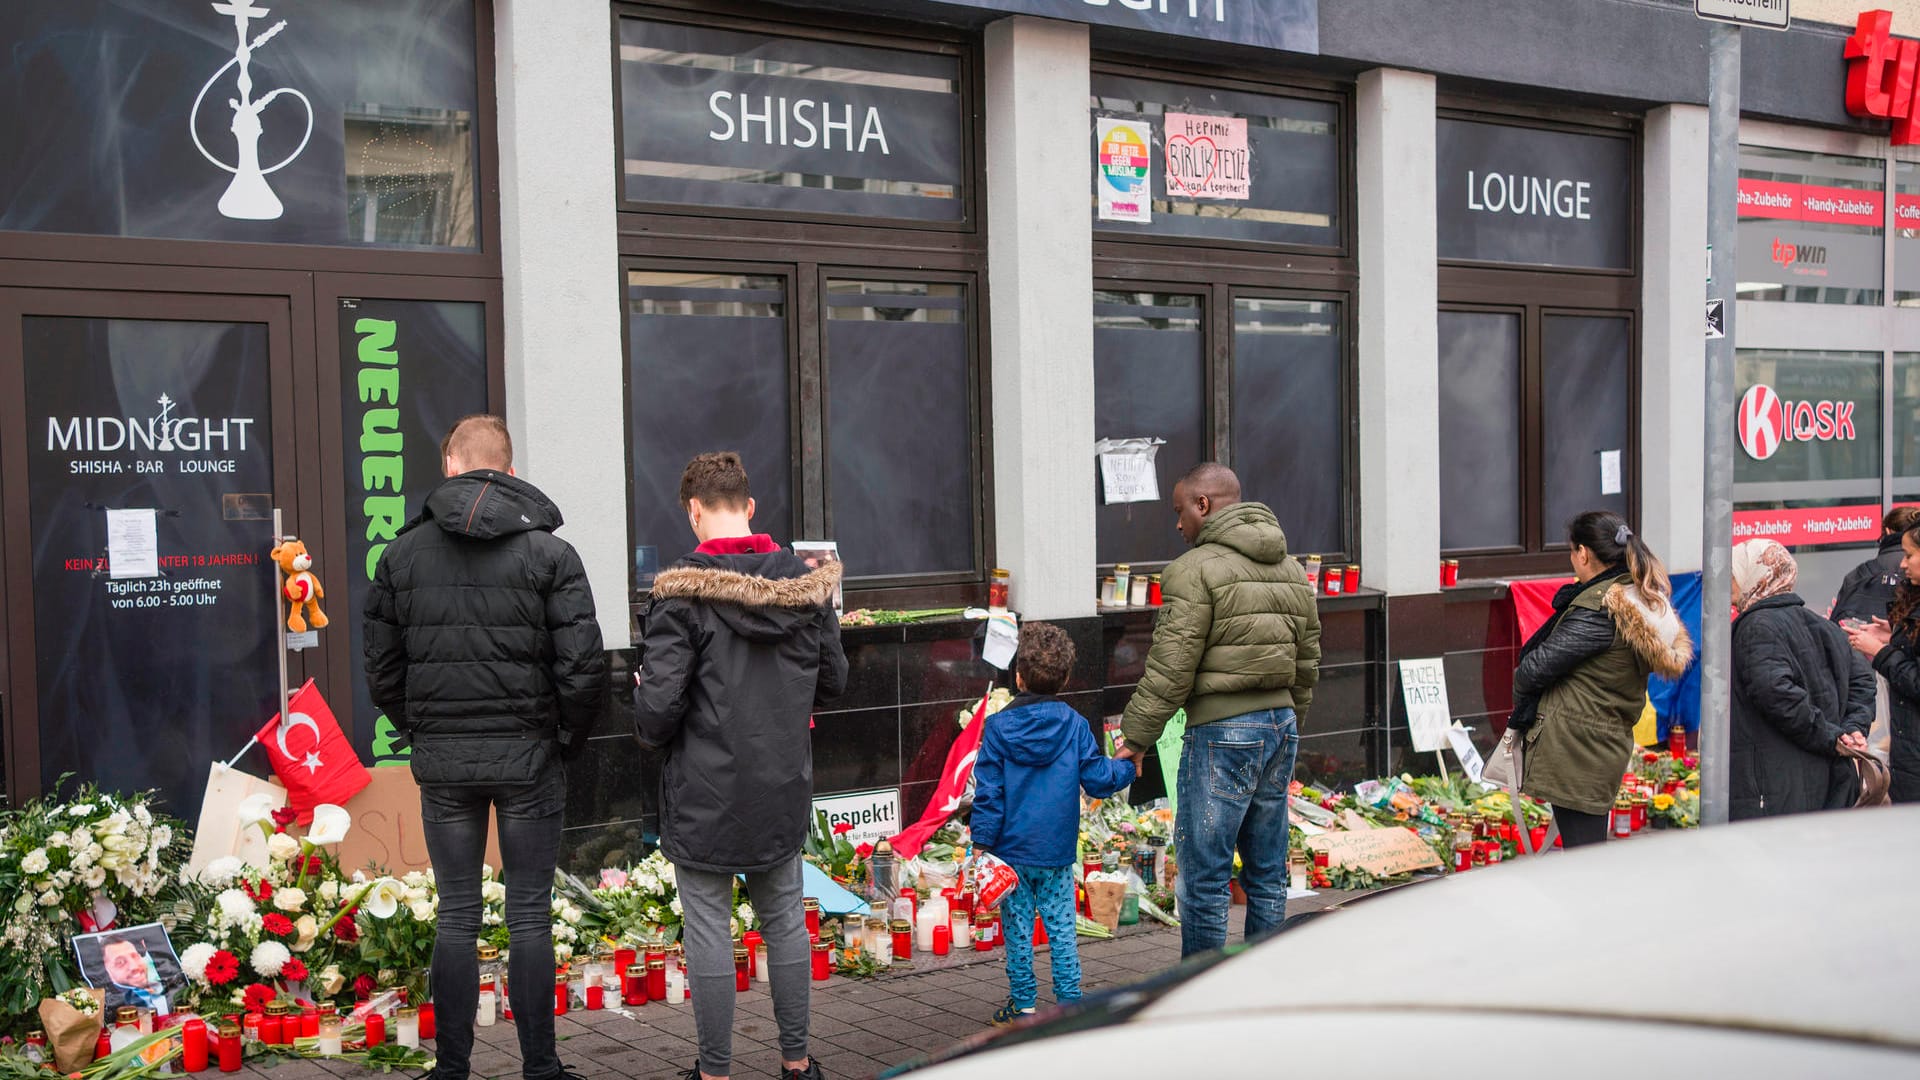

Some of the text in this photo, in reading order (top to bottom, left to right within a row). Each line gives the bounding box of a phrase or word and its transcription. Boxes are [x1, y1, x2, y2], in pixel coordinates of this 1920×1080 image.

[709, 90, 890, 155] SHISHA
[1468, 170, 1591, 220] LOUNGE
[1738, 384, 1856, 461] KIOSK
[70, 460, 236, 474] SHISHA BAR LOUNGE
[65, 558, 93, 570] KEIN
[158, 556, 188, 568] NTER
[192, 556, 205, 567] 18
[207, 553, 253, 567] JAHREN
[105, 577, 222, 596] Täglich 23h geöffnet
[112, 599, 133, 609] von
[136, 595, 161, 608] 6.00
[170, 595, 193, 606] 5.00
[196, 593, 216, 606] Uhr
